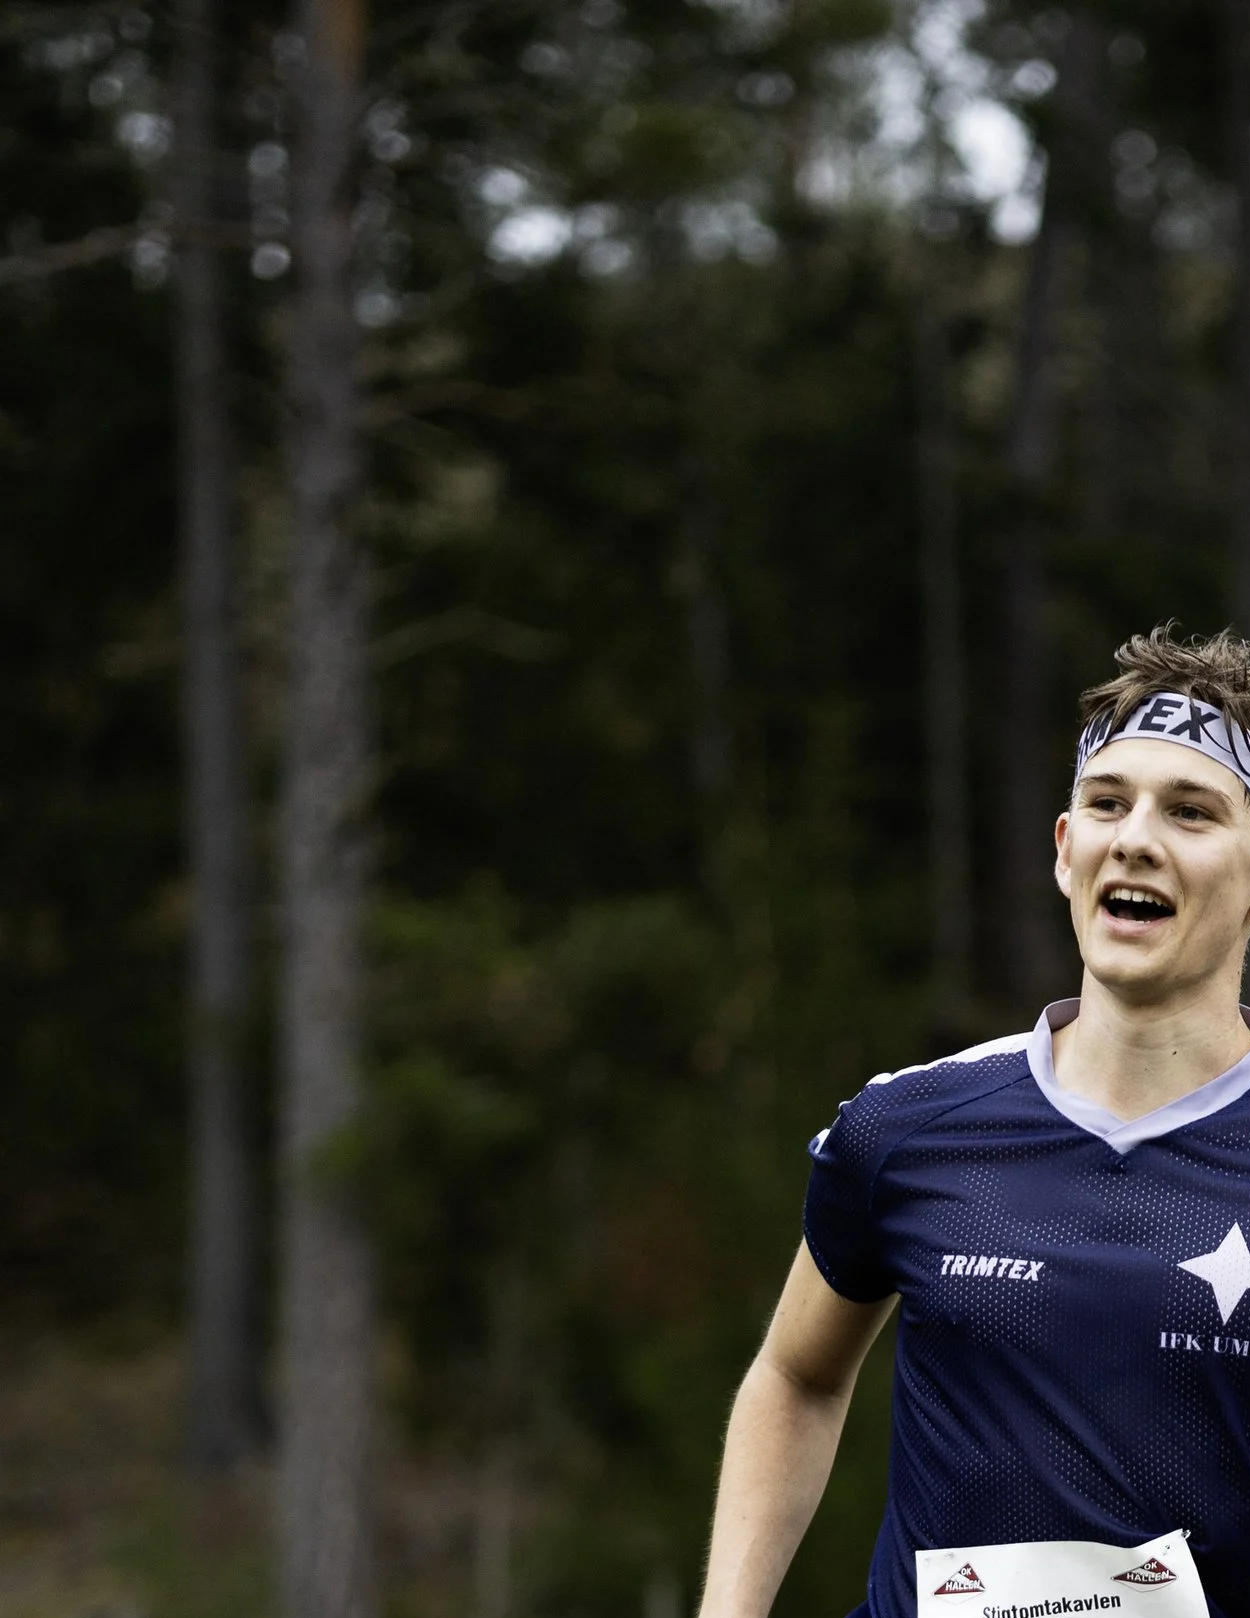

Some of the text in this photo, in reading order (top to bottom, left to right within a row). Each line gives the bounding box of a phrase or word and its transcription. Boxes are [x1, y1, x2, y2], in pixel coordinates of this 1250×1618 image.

[940, 1254, 1046, 1282] TRIMTEX
[1159, 1331, 1203, 1352] IFK
[960, 1567, 972, 1576] OK
[1144, 1561, 1158, 1570] OK
